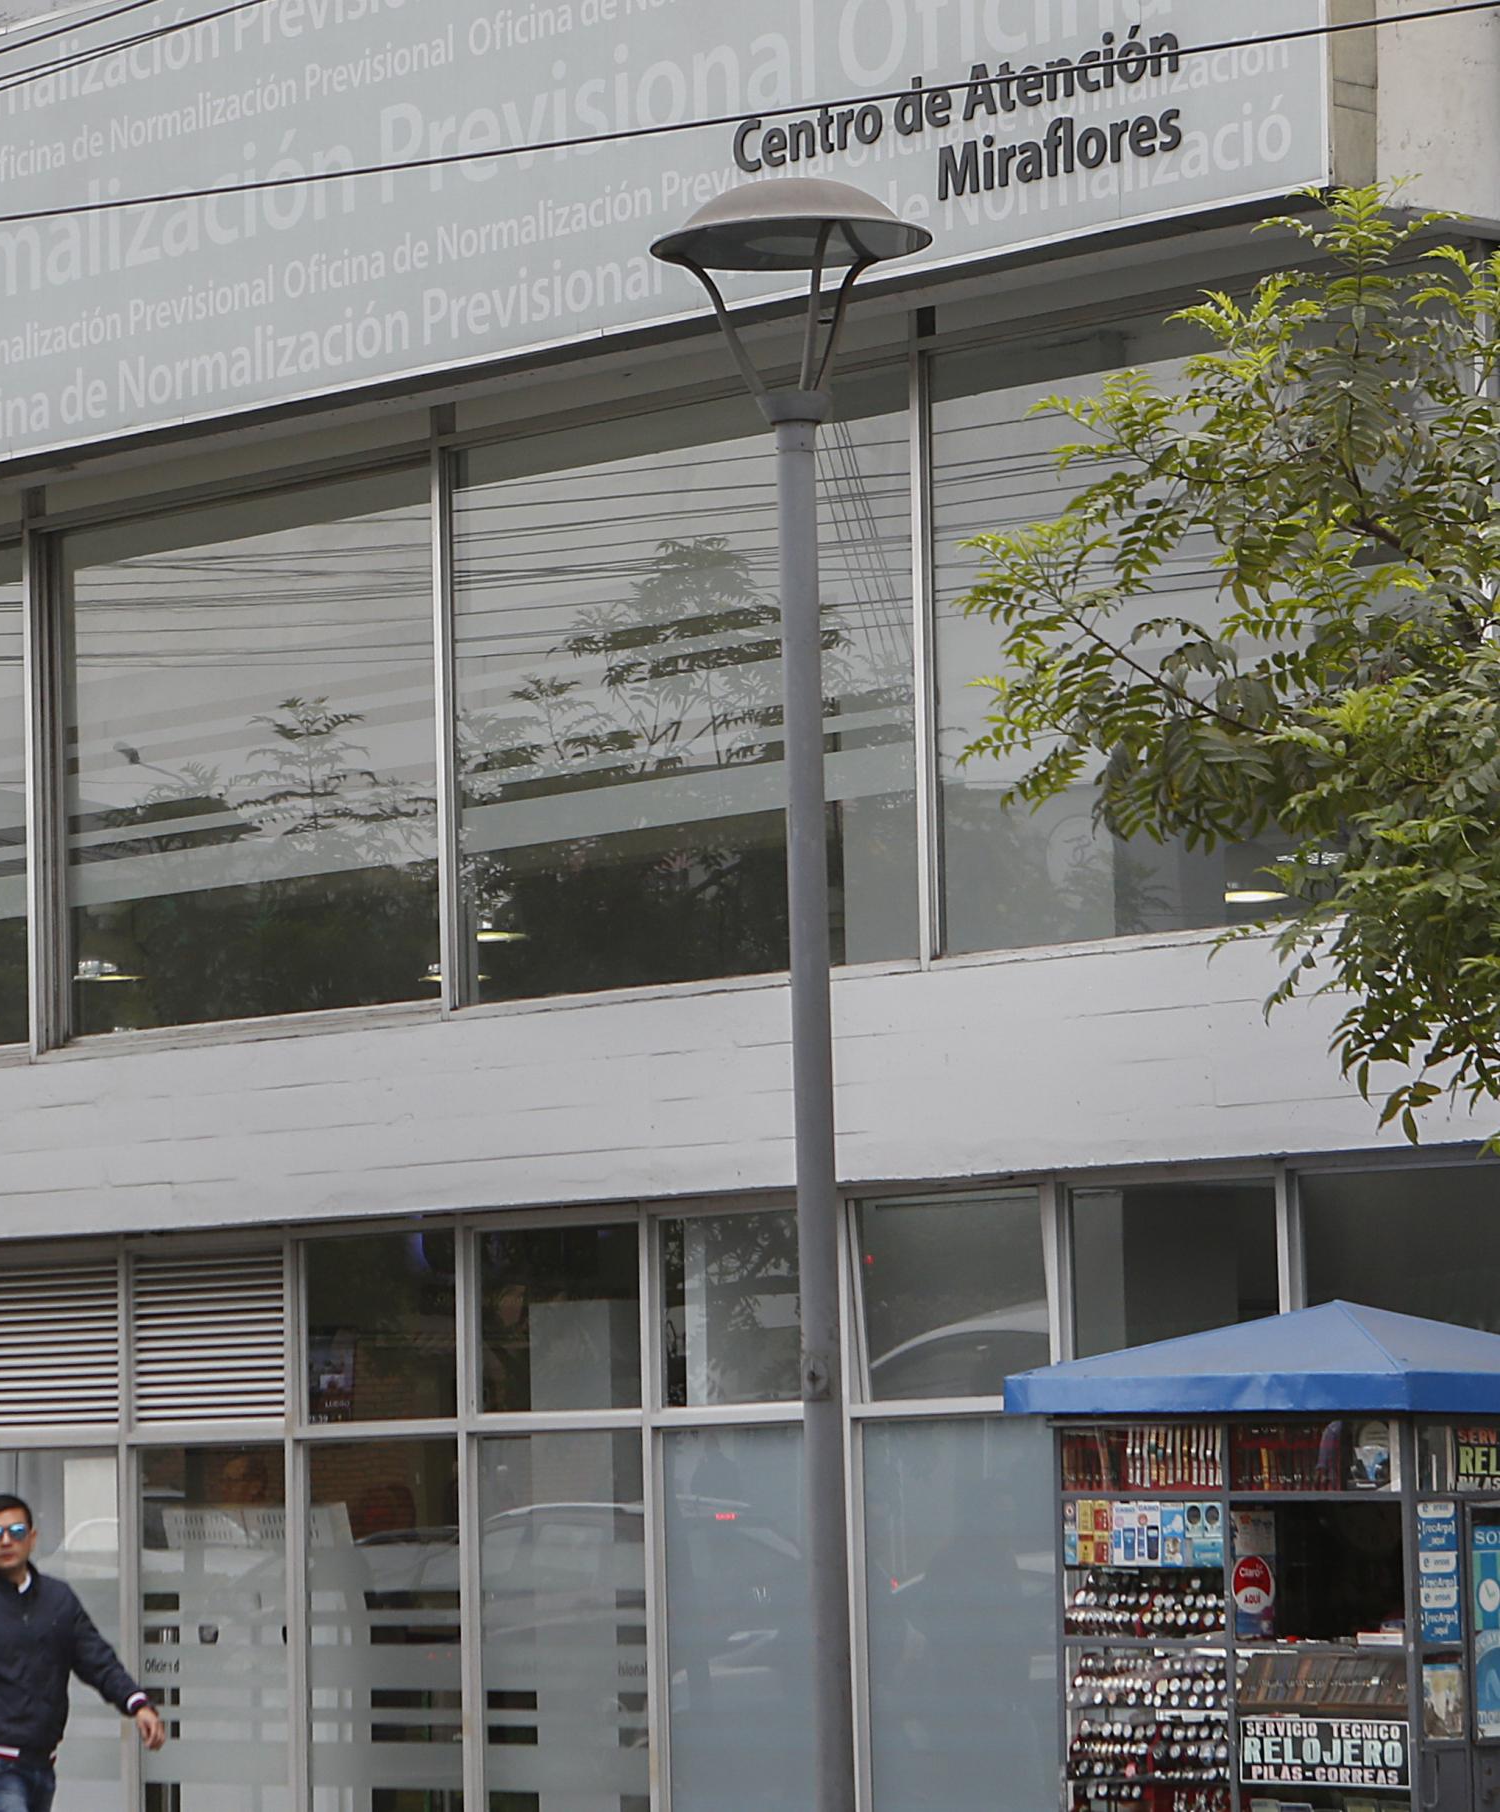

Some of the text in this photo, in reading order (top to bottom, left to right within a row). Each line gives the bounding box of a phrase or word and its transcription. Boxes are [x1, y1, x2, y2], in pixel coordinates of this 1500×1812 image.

[72, 124, 104, 163] de
[110, 73, 298, 155] Normalización
[304, 23, 453, 101] Previsional
[468, 3, 573, 56] Oficina
[380, 0, 817, 205] Previsional
[732, 24, 1180, 173] Centro de Atención
[937, 107, 1183, 201] Miraflores
[129, 264, 274, 331] Previsional
[284, 246, 386, 299] Oficina
[393, 236, 429, 271] de
[436, 178, 652, 265] Normalización
[60, 367, 107, 425] de
[118, 300, 409, 413] Normalización
[423, 232, 664, 346] Previsional
[1239, 1566, 1262, 1578] Claro
[1474, 1530, 1500, 1545] SO
[1243, 1737, 1404, 1768] RELOJERO
[1246, 1721, 1401, 1740] SERVICIO TECNICO
